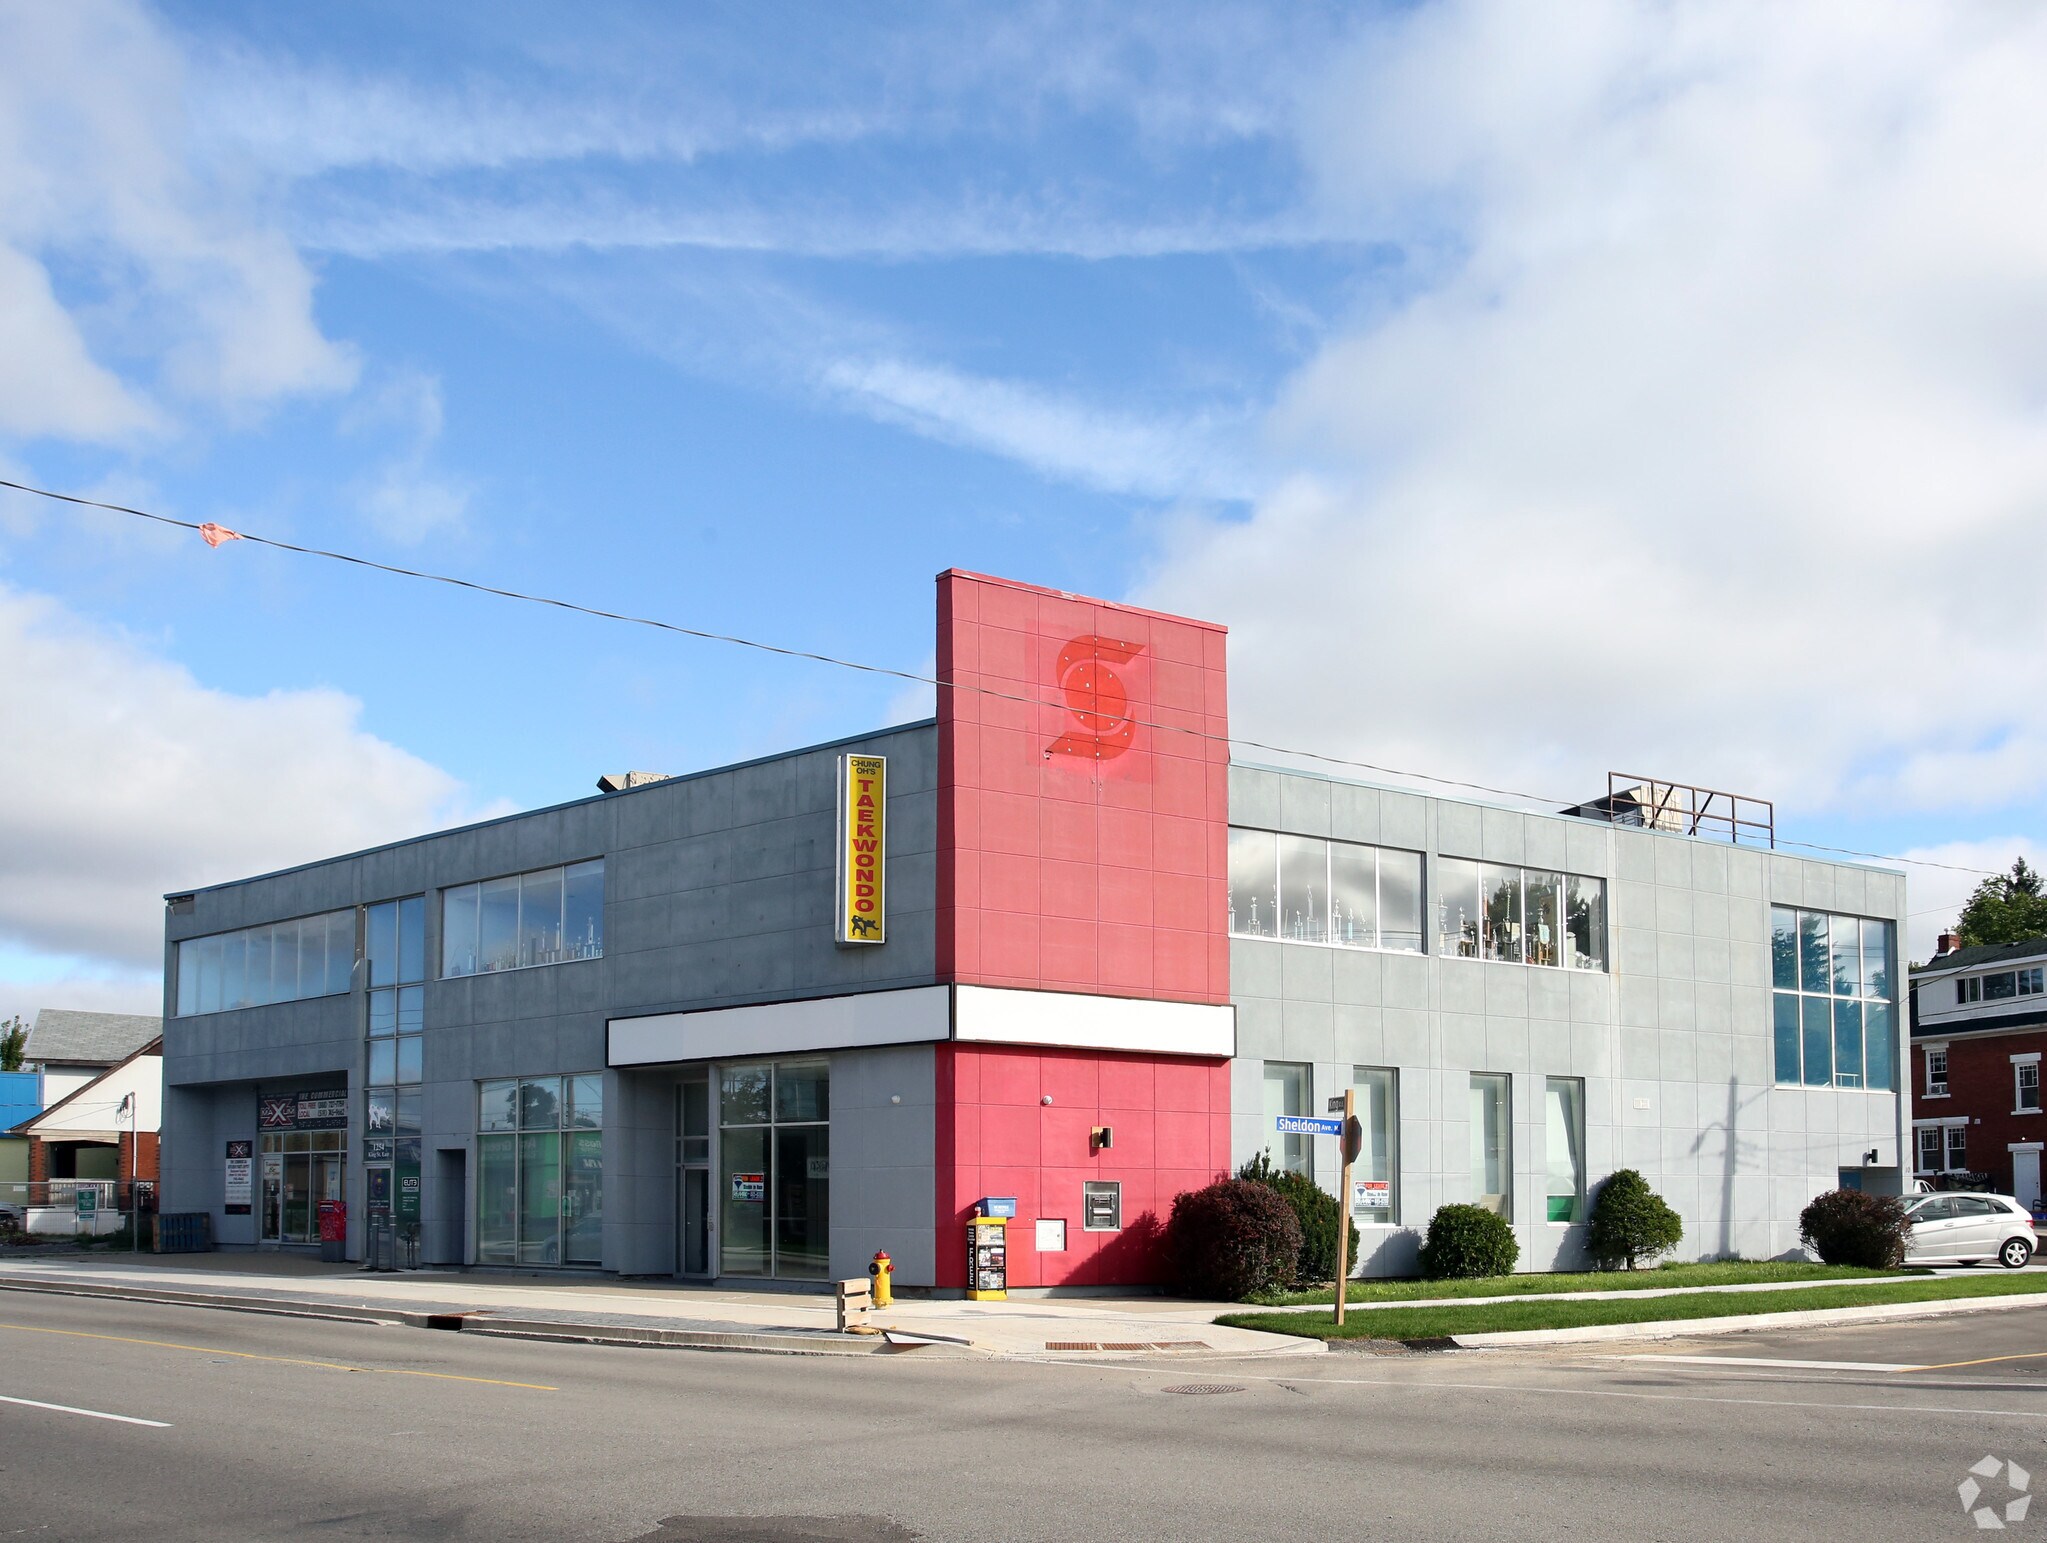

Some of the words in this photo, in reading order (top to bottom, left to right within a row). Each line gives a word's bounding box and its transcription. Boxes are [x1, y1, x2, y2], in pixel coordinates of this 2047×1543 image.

[851, 759, 881, 769] CHUNG
[856, 767, 876, 775] OH'S
[852, 779, 878, 913] TAEKWONDO
[310, 1089, 347, 1099] COMMERCIAL
[1279, 1118, 1321, 1132] Sheldon
[373, 1143, 385, 1151] 1254
